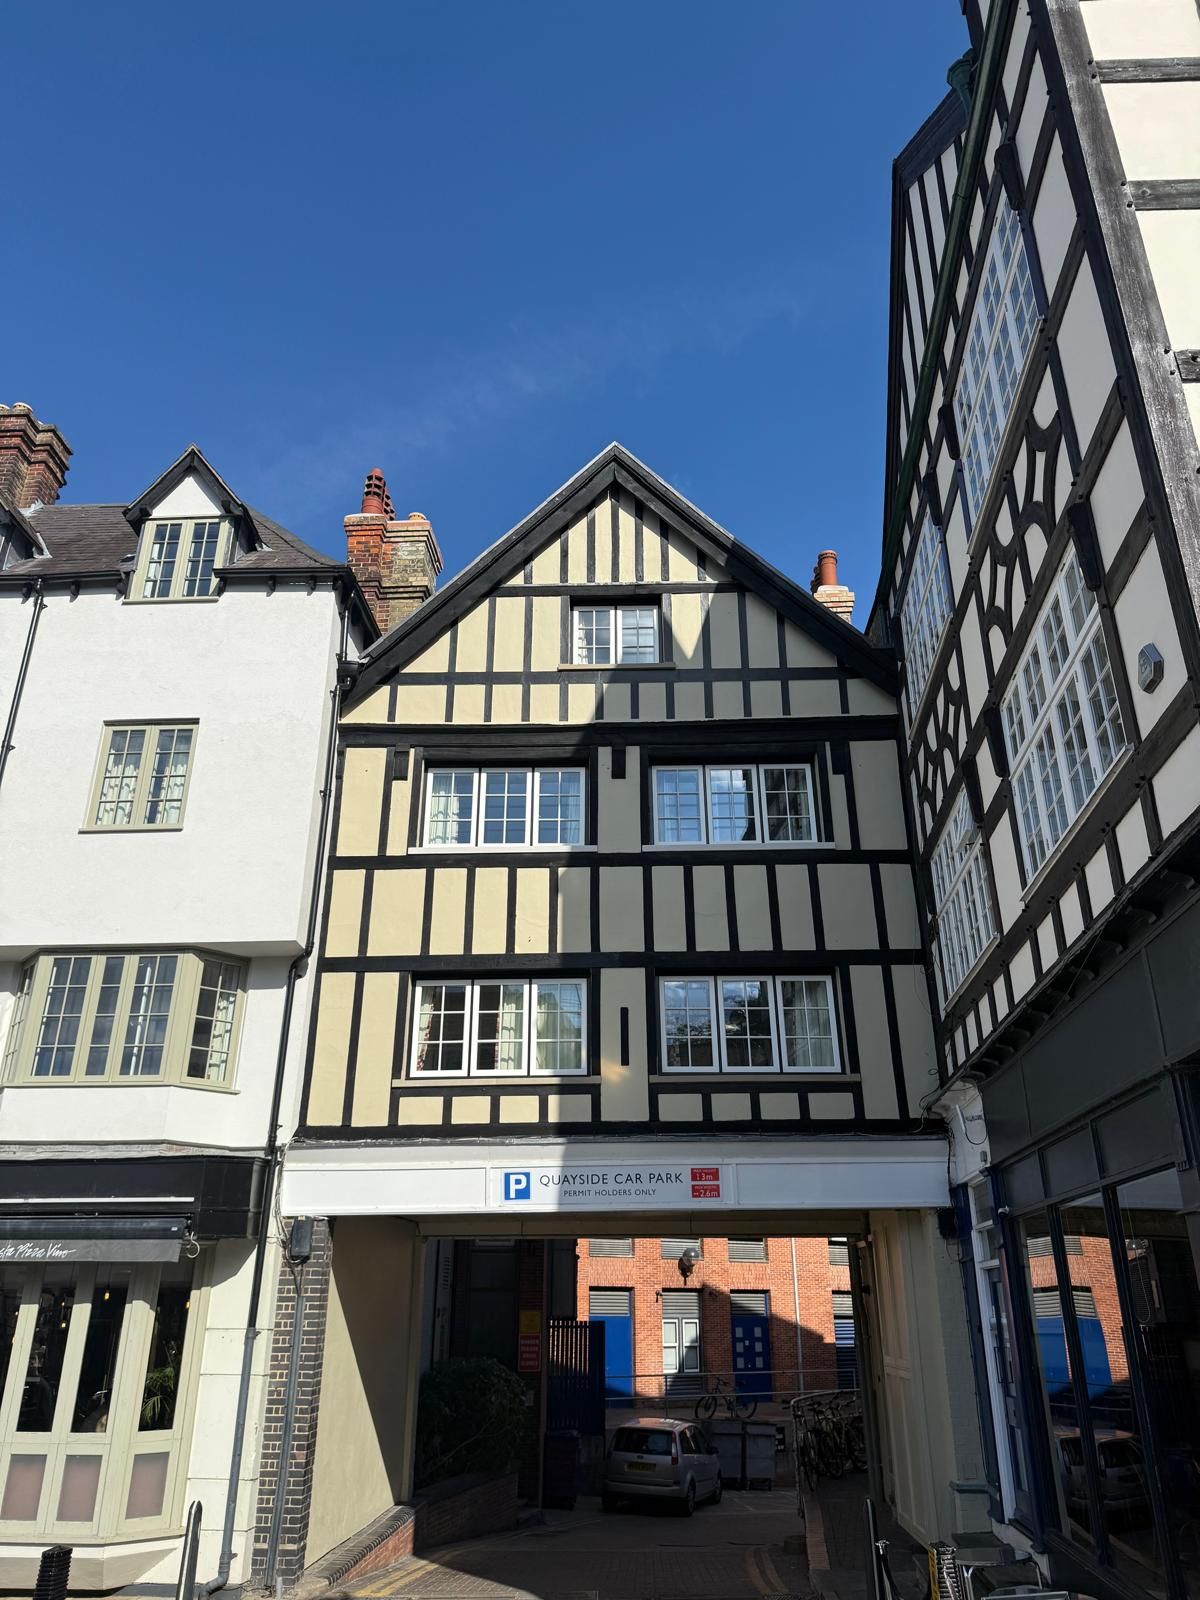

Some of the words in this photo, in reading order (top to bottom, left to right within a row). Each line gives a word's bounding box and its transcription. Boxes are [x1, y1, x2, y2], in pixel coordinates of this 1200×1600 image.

[509, 1174, 527, 1199] P
[539, 1174, 608, 1187] QUAYSIDE
[614, 1173, 643, 1184] CAR
[648, 1172, 684, 1184] PARK
[563, 1189, 592, 1197] PERMIT
[594, 1188, 632, 1196] HOLDERS
[634, 1188, 656, 1196] ONLY
[46, 1242, 77, 1258] Vino
